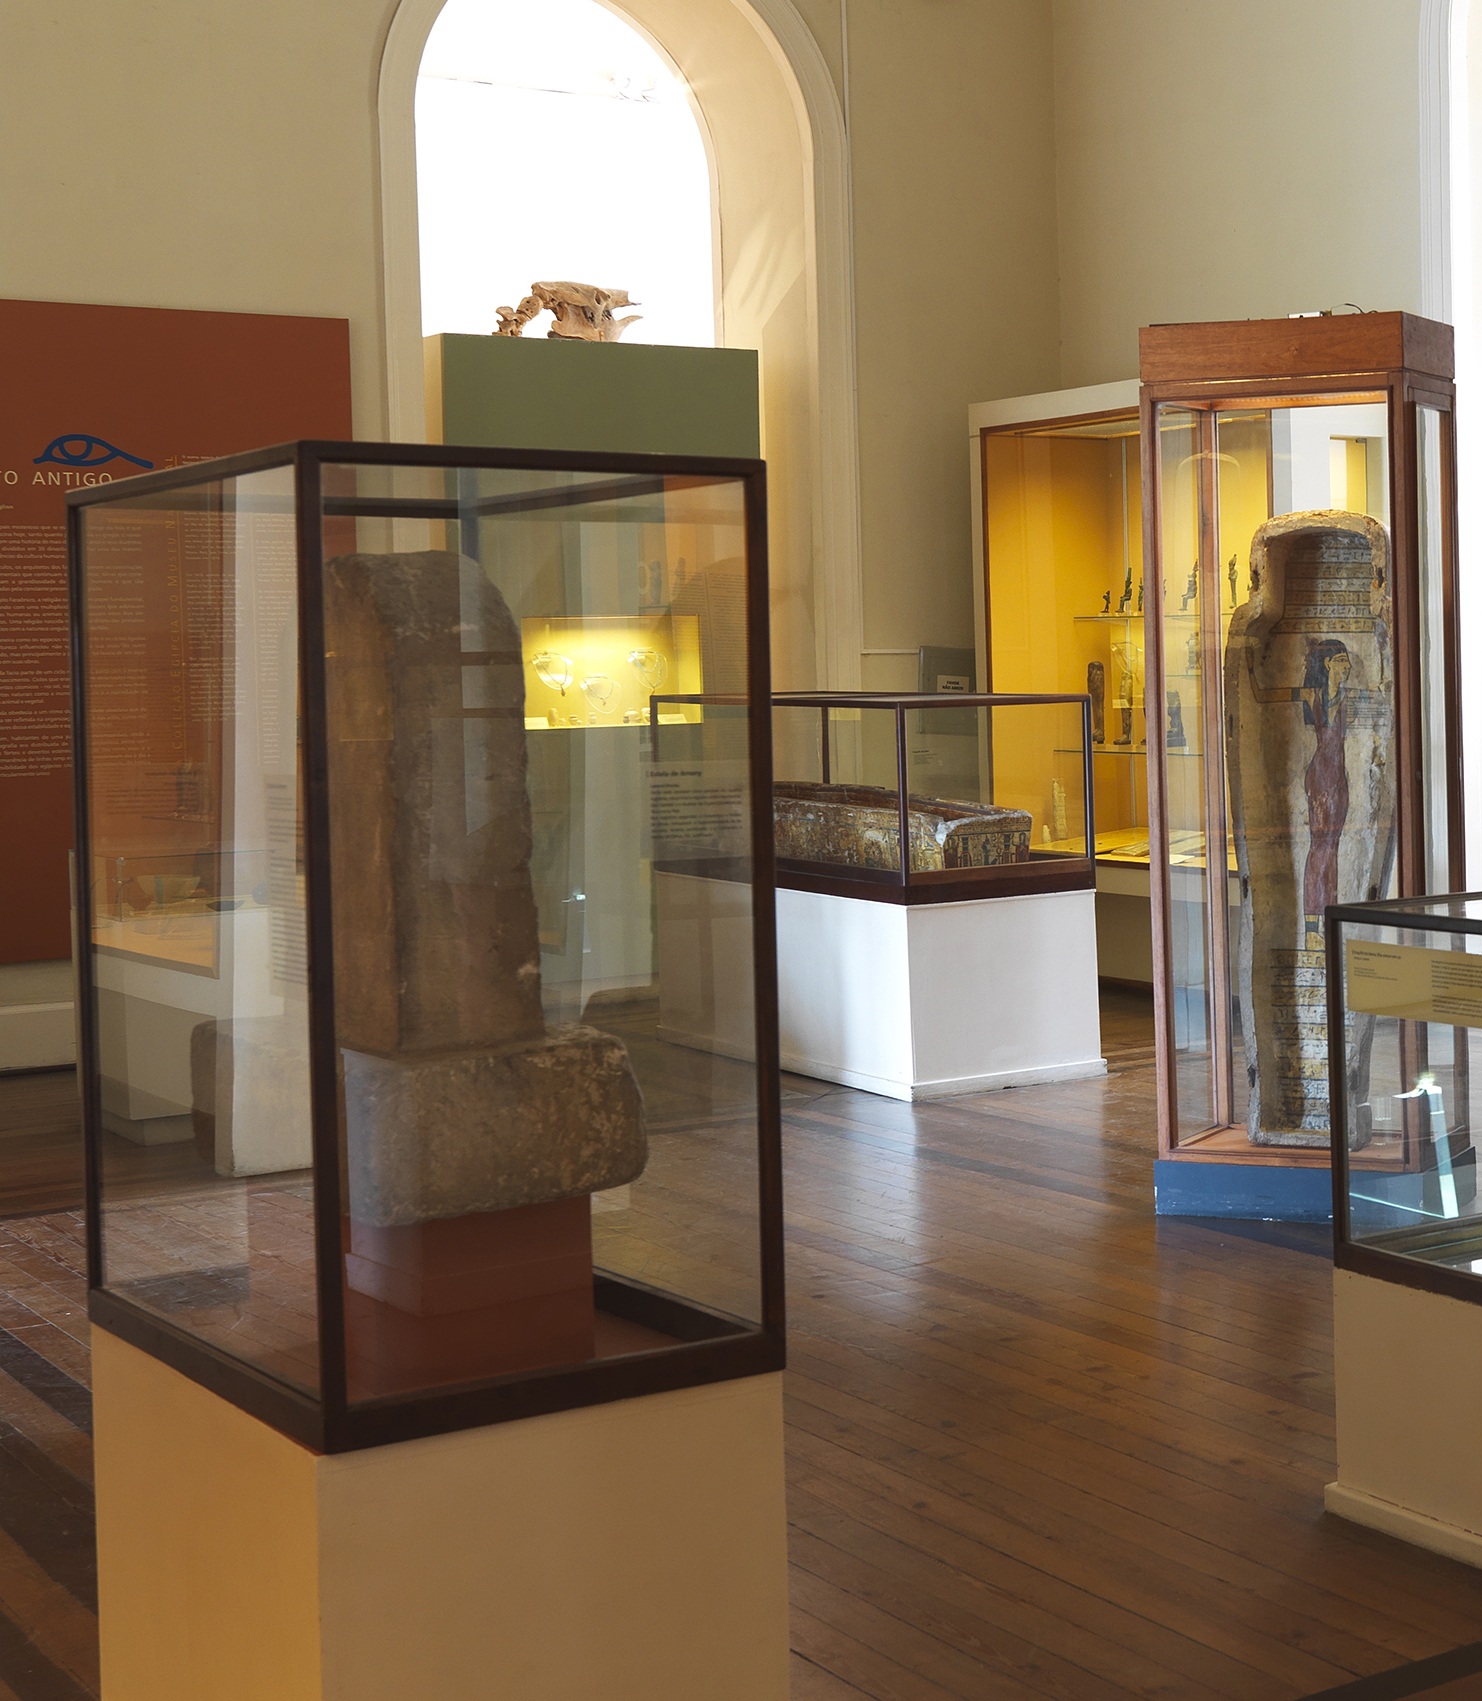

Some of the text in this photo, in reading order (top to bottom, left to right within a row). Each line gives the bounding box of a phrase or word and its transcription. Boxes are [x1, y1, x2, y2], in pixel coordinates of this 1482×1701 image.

[32, 471, 113, 487] ANTIGO
[167, 537, 179, 587] MUSEU
[170, 594, 180, 612] DO
